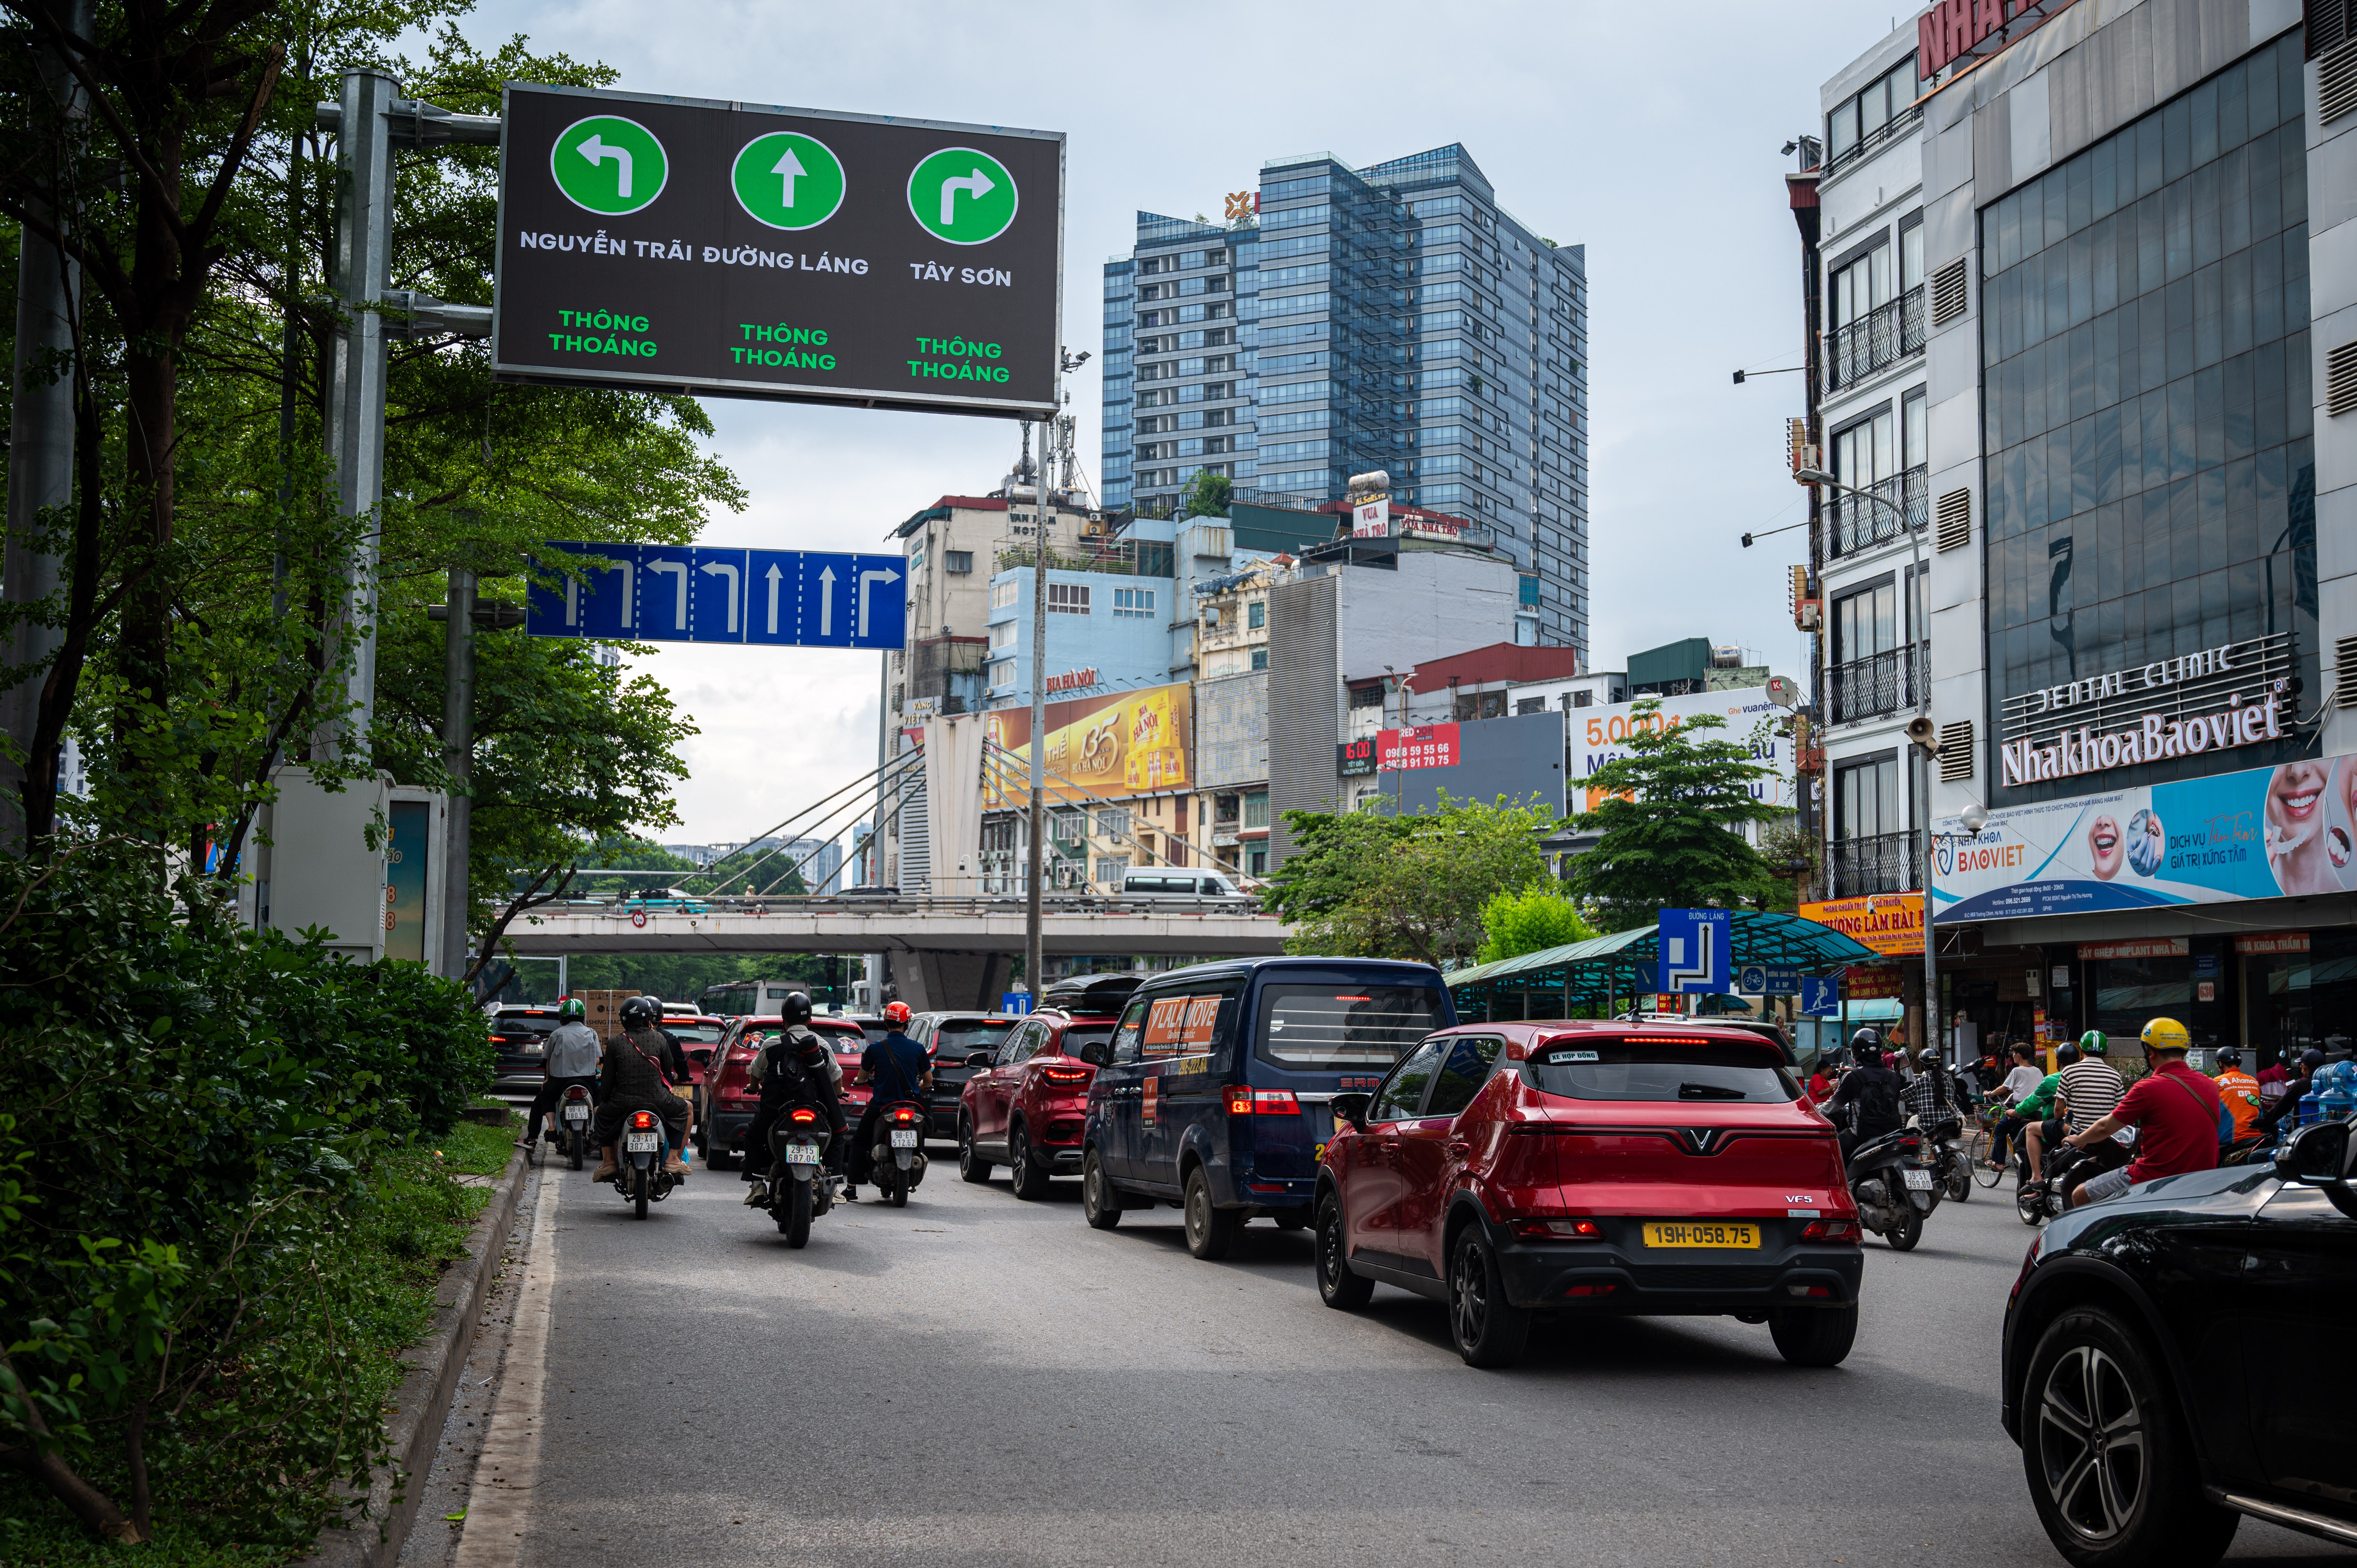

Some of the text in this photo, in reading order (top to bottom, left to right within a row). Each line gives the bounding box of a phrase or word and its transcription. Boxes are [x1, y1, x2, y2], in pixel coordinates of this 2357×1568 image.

[520, 230, 692, 261] NGUYỄN TRÃI
[703, 244, 869, 275] ĐƯỜNG LÁNG
[910, 260, 1012, 287] TÂY SƠN
[559, 307, 650, 333] THÔNG
[740, 321, 829, 346] THÔNG
[549, 332, 657, 358] THOÁNG
[916, 335, 1002, 359] THÔNG
[730, 346, 837, 371] THOÁNG
[907, 360, 1010, 384] THOÁNG
[1362, 506, 1378, 520] VUA
[1422, 521, 1440, 533] NHÀ
[1046, 667, 1096, 692] BIA HÀ NỘI
[2038, 644, 2236, 713] DENTAL CLINIC
[913, 700, 932, 710] VÀNG
[1139, 704, 1148, 717] BIA
[903, 712, 921, 726] VIỆT
[1047, 733, 1067, 763] THẾ
[1410, 745, 1421, 756] 59
[1424, 744, 1435, 754] 55
[1438, 743, 1449, 753] 66
[1072, 755, 1107, 773] BIA HÀ NỘI
[1410, 754, 1449, 767] 91 70 75
[2170, 834, 2191, 851] DỊCH
[2192, 832, 2205, 848] VỤ
[1959, 844, 2025, 872] BAOVIET
[2171, 844, 2246, 869] GIÁ TRỊ XỨNG TẦM
[1689, 911, 1724, 920] ĐƯỜNG LÁNG
[1892, 904, 1915, 929] HẢI
[2078, 944, 2173, 958] CẤY GHÉP IMPLANT NHA
[2236, 935, 2300, 952] NHA KHOA THẨM
[1860, 988, 1871, 996] LINH
[2199, 985, 2214, 998] 630
[1158, 1001, 1219, 1029] LALAMOVE
[2037, 1033, 2045, 1042] XAY
[1341, 1078, 1379, 1088] SRM
[629, 1142, 655, 1151] 387.39
[791, 1146, 814, 1154] 29-Y5
[788, 1154, 816, 1163] 687.04
[1907, 1180, 1931, 1189] 399.00
[1908, 1172, 1928, 1180] 19-S1
[1785, 1195, 1813, 1203] VF5
[1655, 1226, 1751, 1245] 19H-058.75
